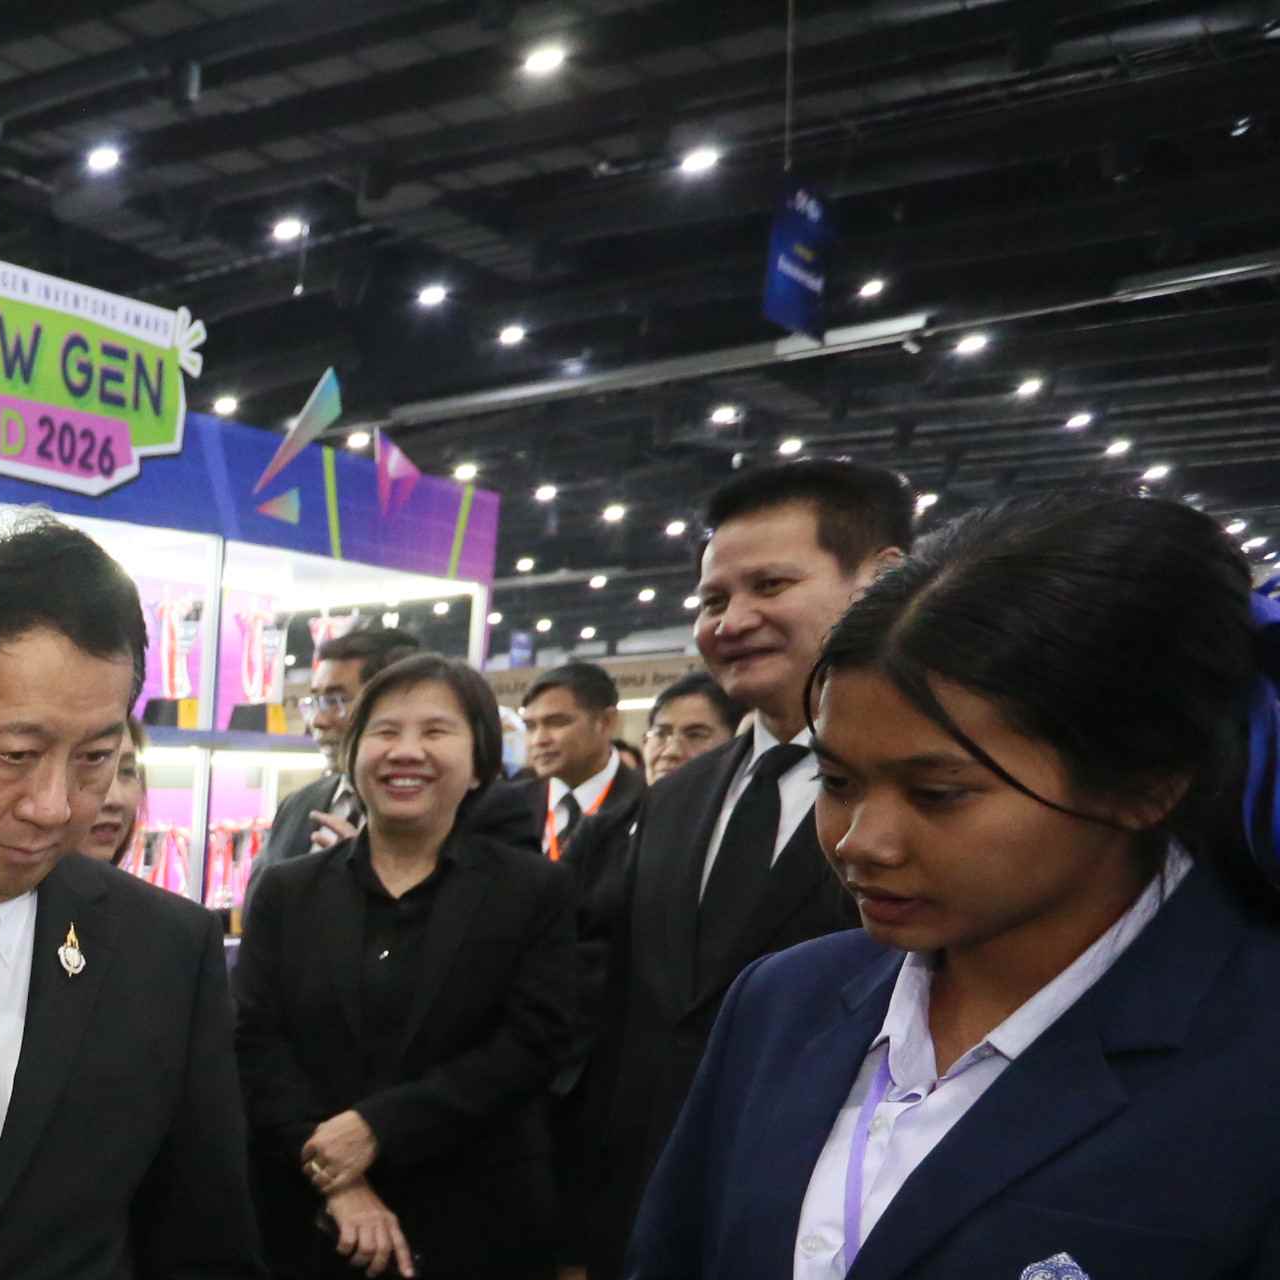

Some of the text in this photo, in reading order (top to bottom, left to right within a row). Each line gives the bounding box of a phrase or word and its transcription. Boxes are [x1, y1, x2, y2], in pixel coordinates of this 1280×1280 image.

[0, 268, 30, 294] GEN
[60, 332, 166, 417] GEN
[35, 414, 117, 479] 2026
